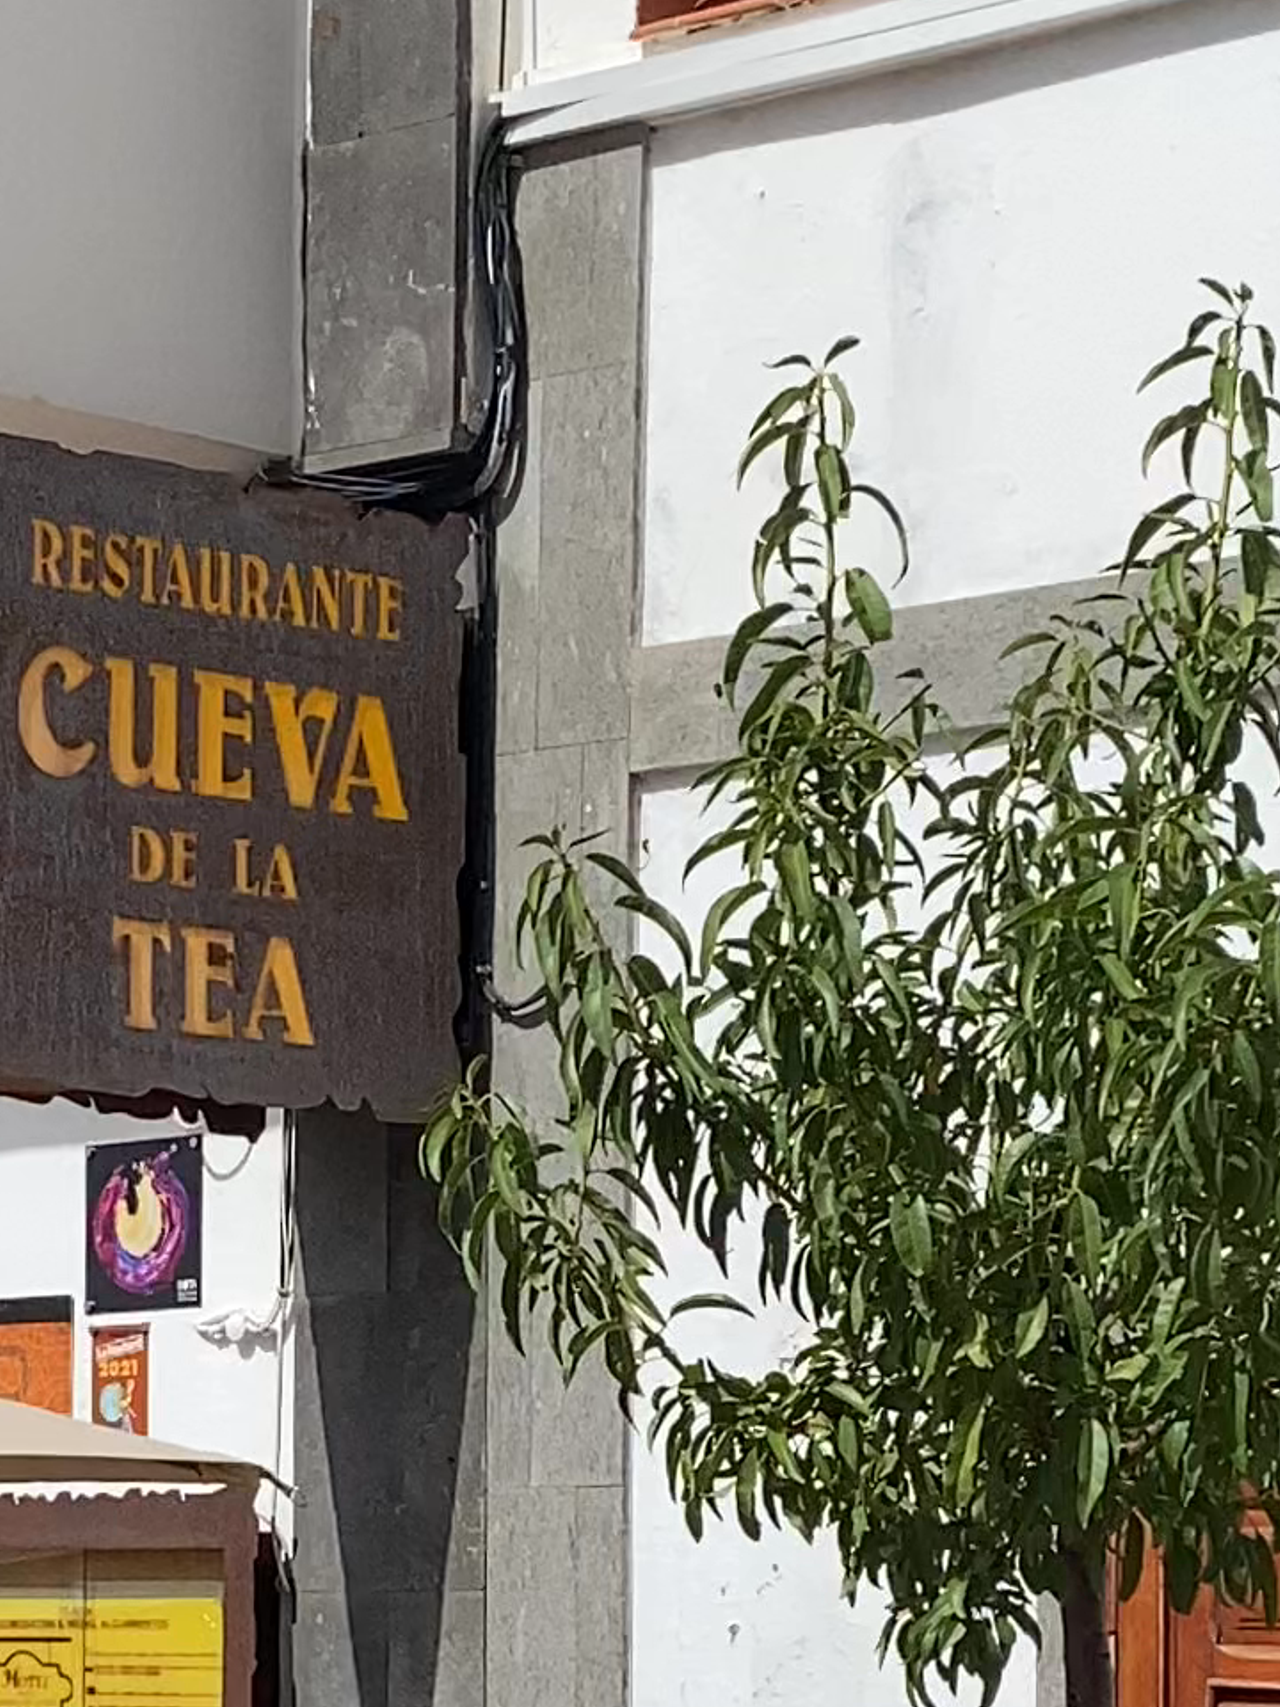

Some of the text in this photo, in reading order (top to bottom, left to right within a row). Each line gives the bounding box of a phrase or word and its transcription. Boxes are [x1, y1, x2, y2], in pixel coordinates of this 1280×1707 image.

[32, 518, 403, 642] RESTAURANTE
[17, 645, 409, 823] CUEVA
[129, 825, 299, 901] DE LA
[112, 916, 315, 1047] TEA
[99, 1359, 139, 1378] 2021
